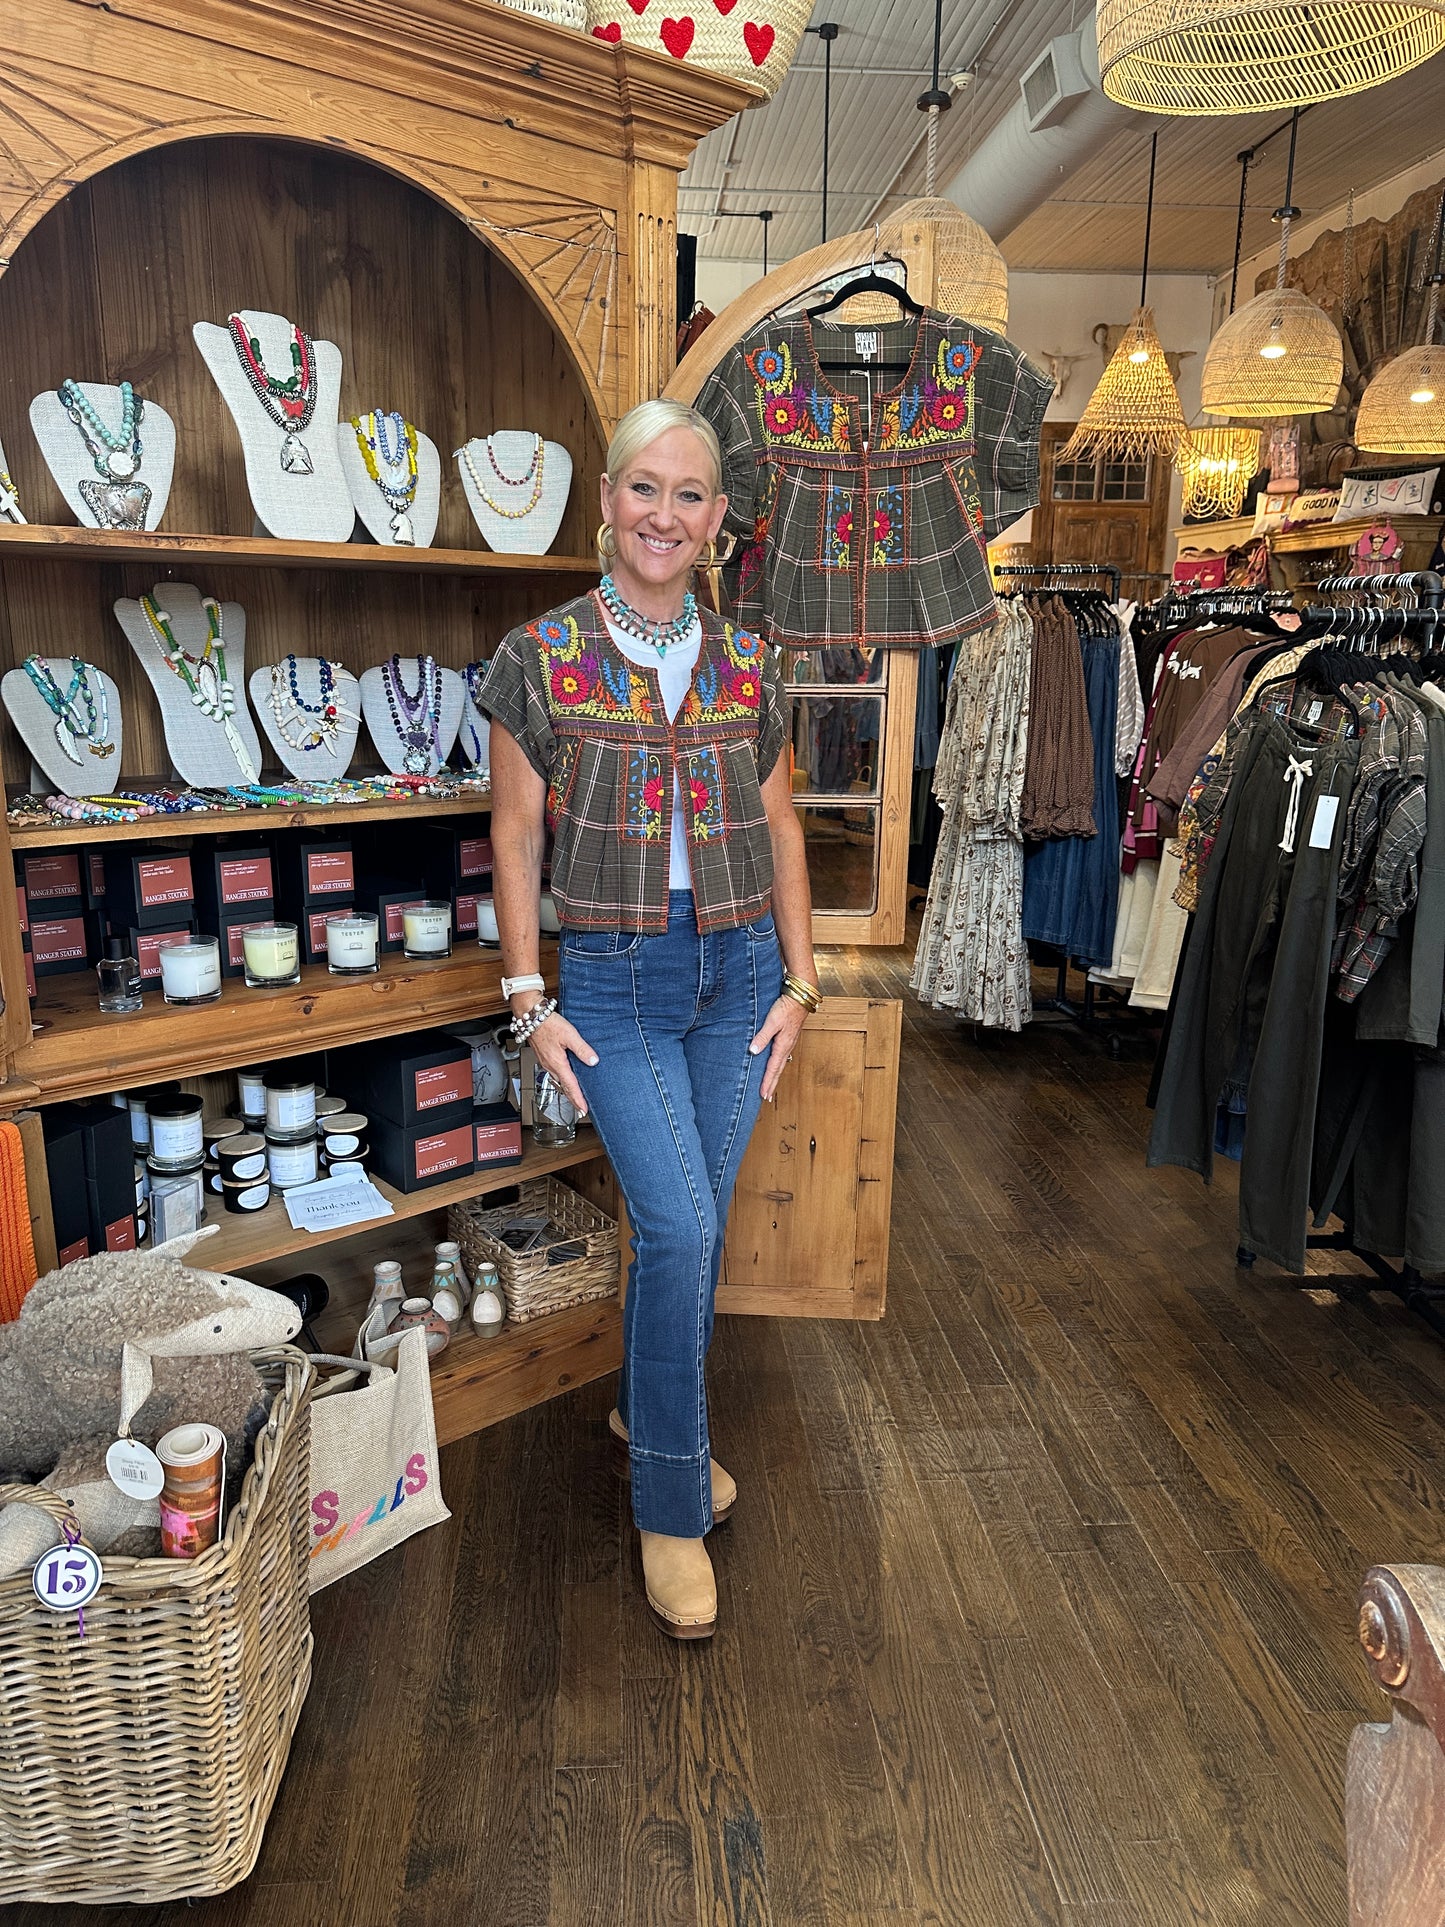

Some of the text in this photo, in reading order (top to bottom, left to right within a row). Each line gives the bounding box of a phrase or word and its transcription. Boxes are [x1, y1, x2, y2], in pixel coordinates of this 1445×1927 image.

[856, 342, 876, 352] MARY
[1302, 499, 1328, 510] GOOD
[30, 886, 77, 897] RANGER STATION
[311, 883, 332, 891] RANGER
[332, 881, 352, 889] STATION
[145, 893, 167, 903] RANGER
[167, 890, 189, 900] STATION
[225, 892, 248, 901] RANGER
[247, 889, 269, 899] STATION
[36, 949, 82, 961] RANGER STATION
[419, 1097, 439, 1108] RANGER
[439, 1092, 459, 1103] STATION
[480, 1150, 499, 1159] RANGER
[499, 1147, 519, 1157] STATION
[418, 1164, 439, 1176] RANGER
[438, 1159, 458, 1170] STATION
[306, 1199, 361, 1213] Thank you
[46, 1560, 88, 1595] 15
